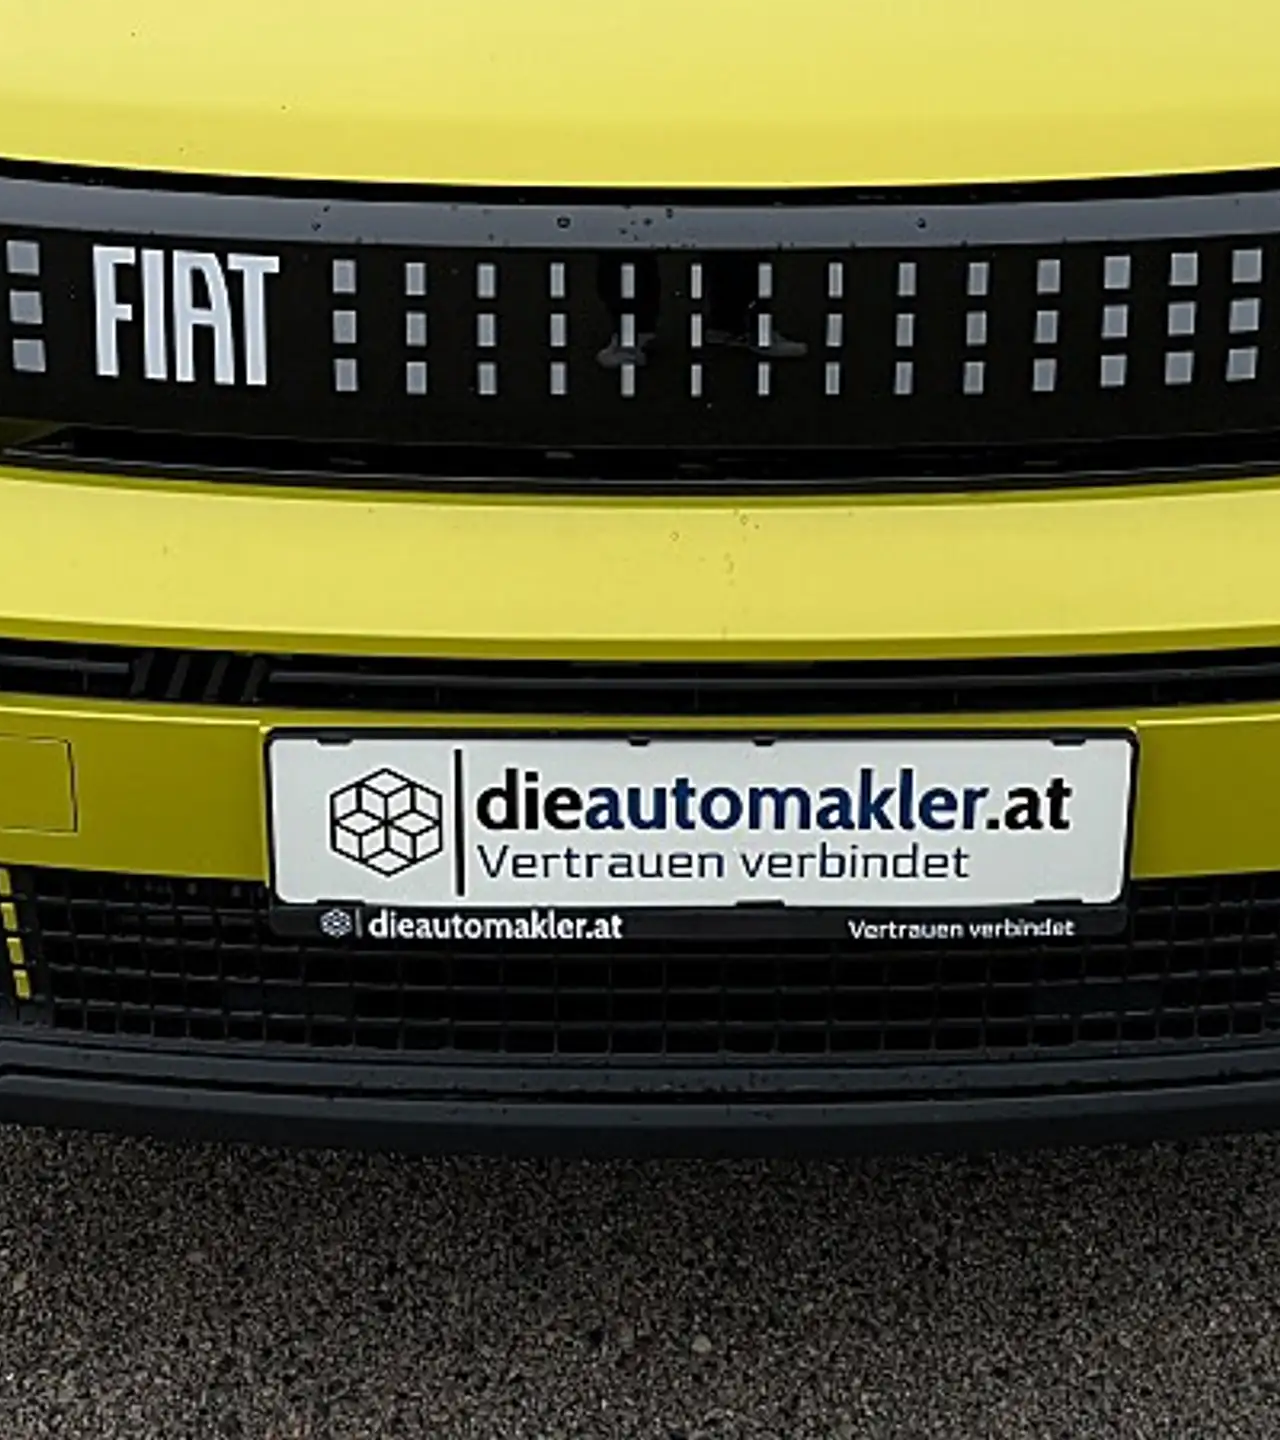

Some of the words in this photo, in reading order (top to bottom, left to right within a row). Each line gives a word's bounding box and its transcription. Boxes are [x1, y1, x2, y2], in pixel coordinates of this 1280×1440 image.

[93, 245, 280, 386] FIAT
[476, 768, 1073, 830] dieautomakler.at
[476, 844, 724, 879] Vertrauen
[740, 842, 970, 879] verbindet
[369, 909, 624, 939] dieautomakler.at
[847, 920, 964, 939] Vertrauen
[969, 918, 1076, 938] verbindet
